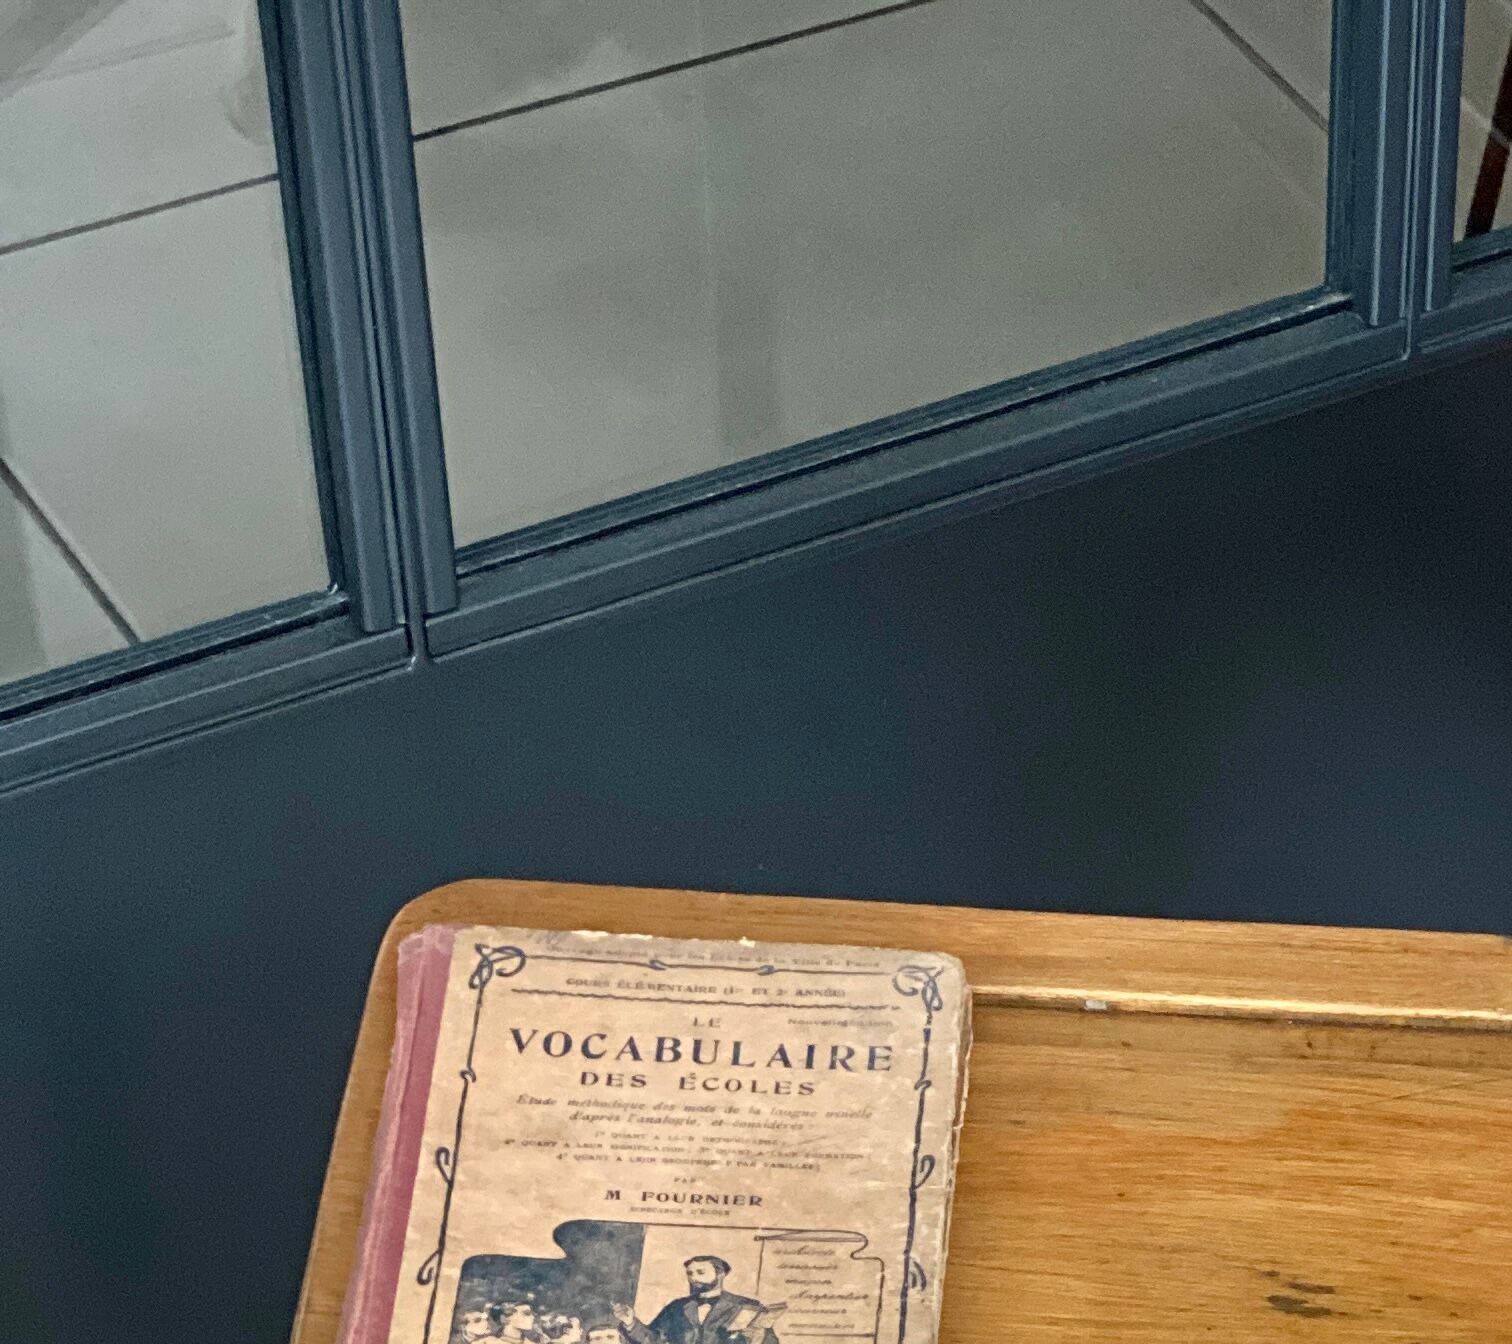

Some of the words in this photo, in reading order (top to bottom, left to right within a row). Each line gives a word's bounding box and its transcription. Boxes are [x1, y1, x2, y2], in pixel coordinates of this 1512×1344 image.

[692, 1016, 722, 1028] LE
[509, 1027, 893, 1073] VOCABULAIRE
[579, 1071, 647, 1088] DES
[679, 1072, 815, 1096] ÉCOLES
[641, 1191, 763, 1206] FOURNIER
